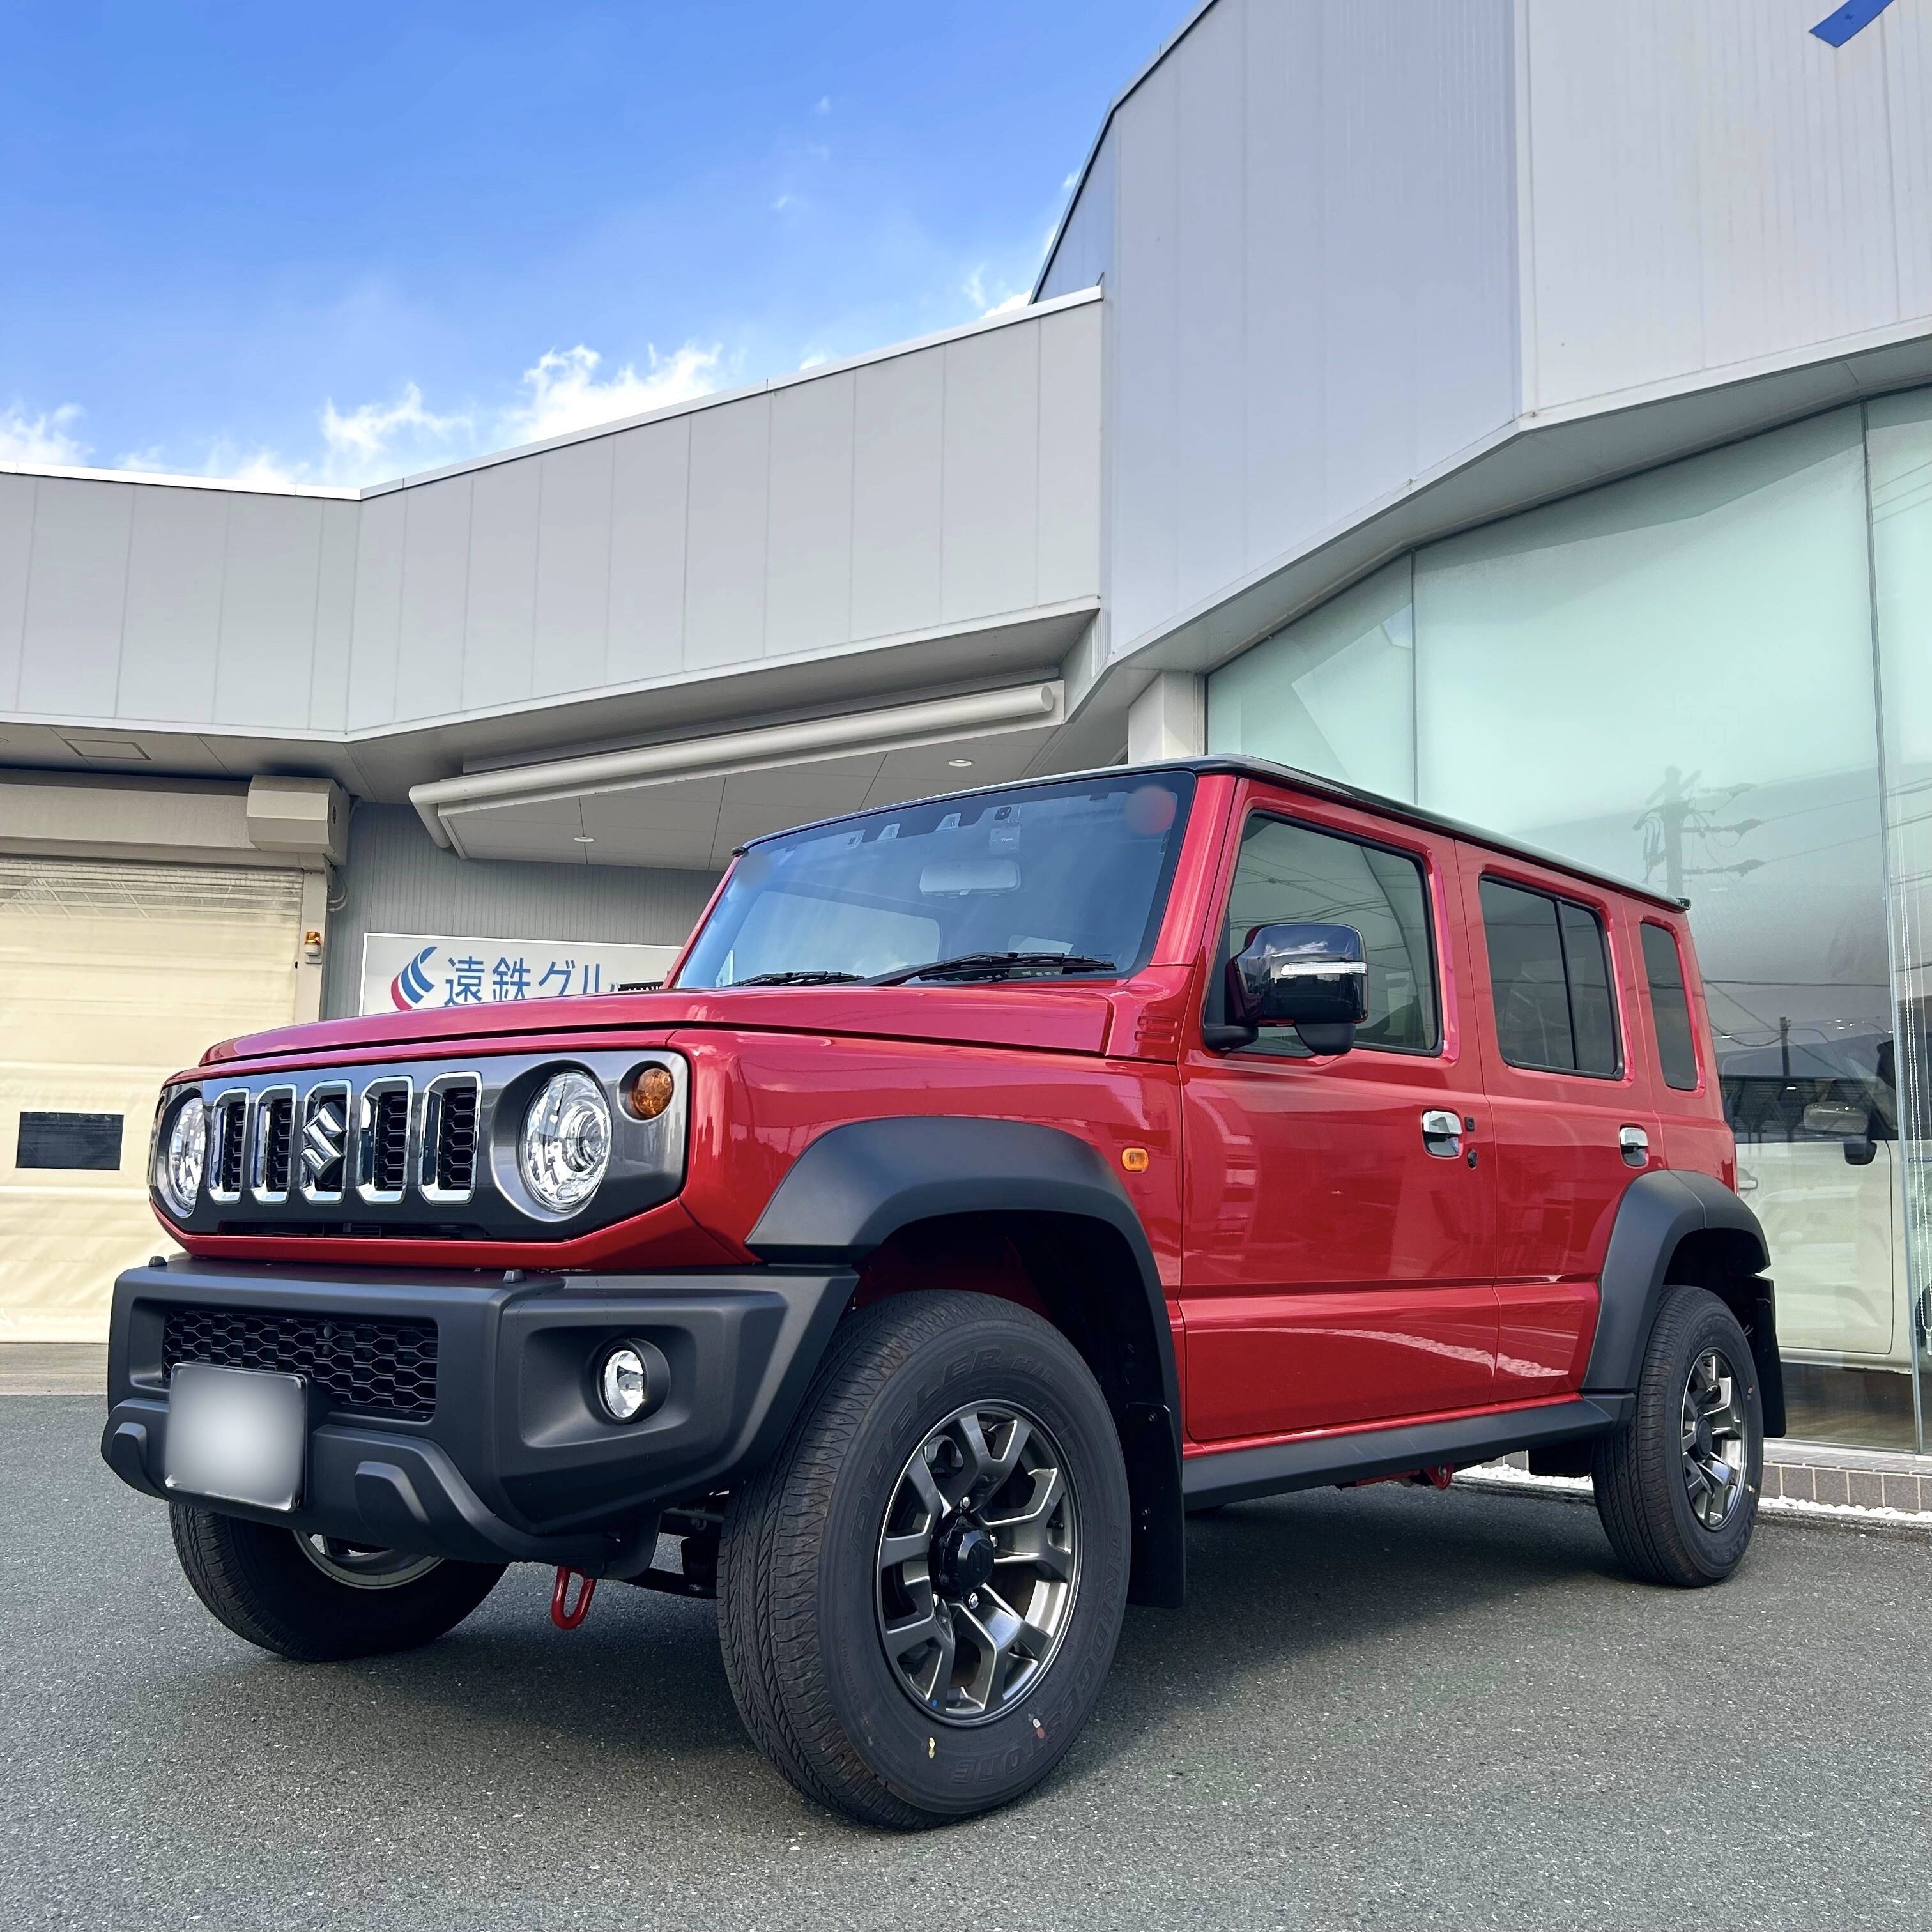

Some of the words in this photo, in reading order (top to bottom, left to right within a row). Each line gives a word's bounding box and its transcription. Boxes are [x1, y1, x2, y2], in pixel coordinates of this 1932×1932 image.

[850, 1345, 1004, 1556] DUELER
[1011, 1355, 1055, 1387] H/L
[951, 1523, 1122, 1784] BRIDGESTONE
